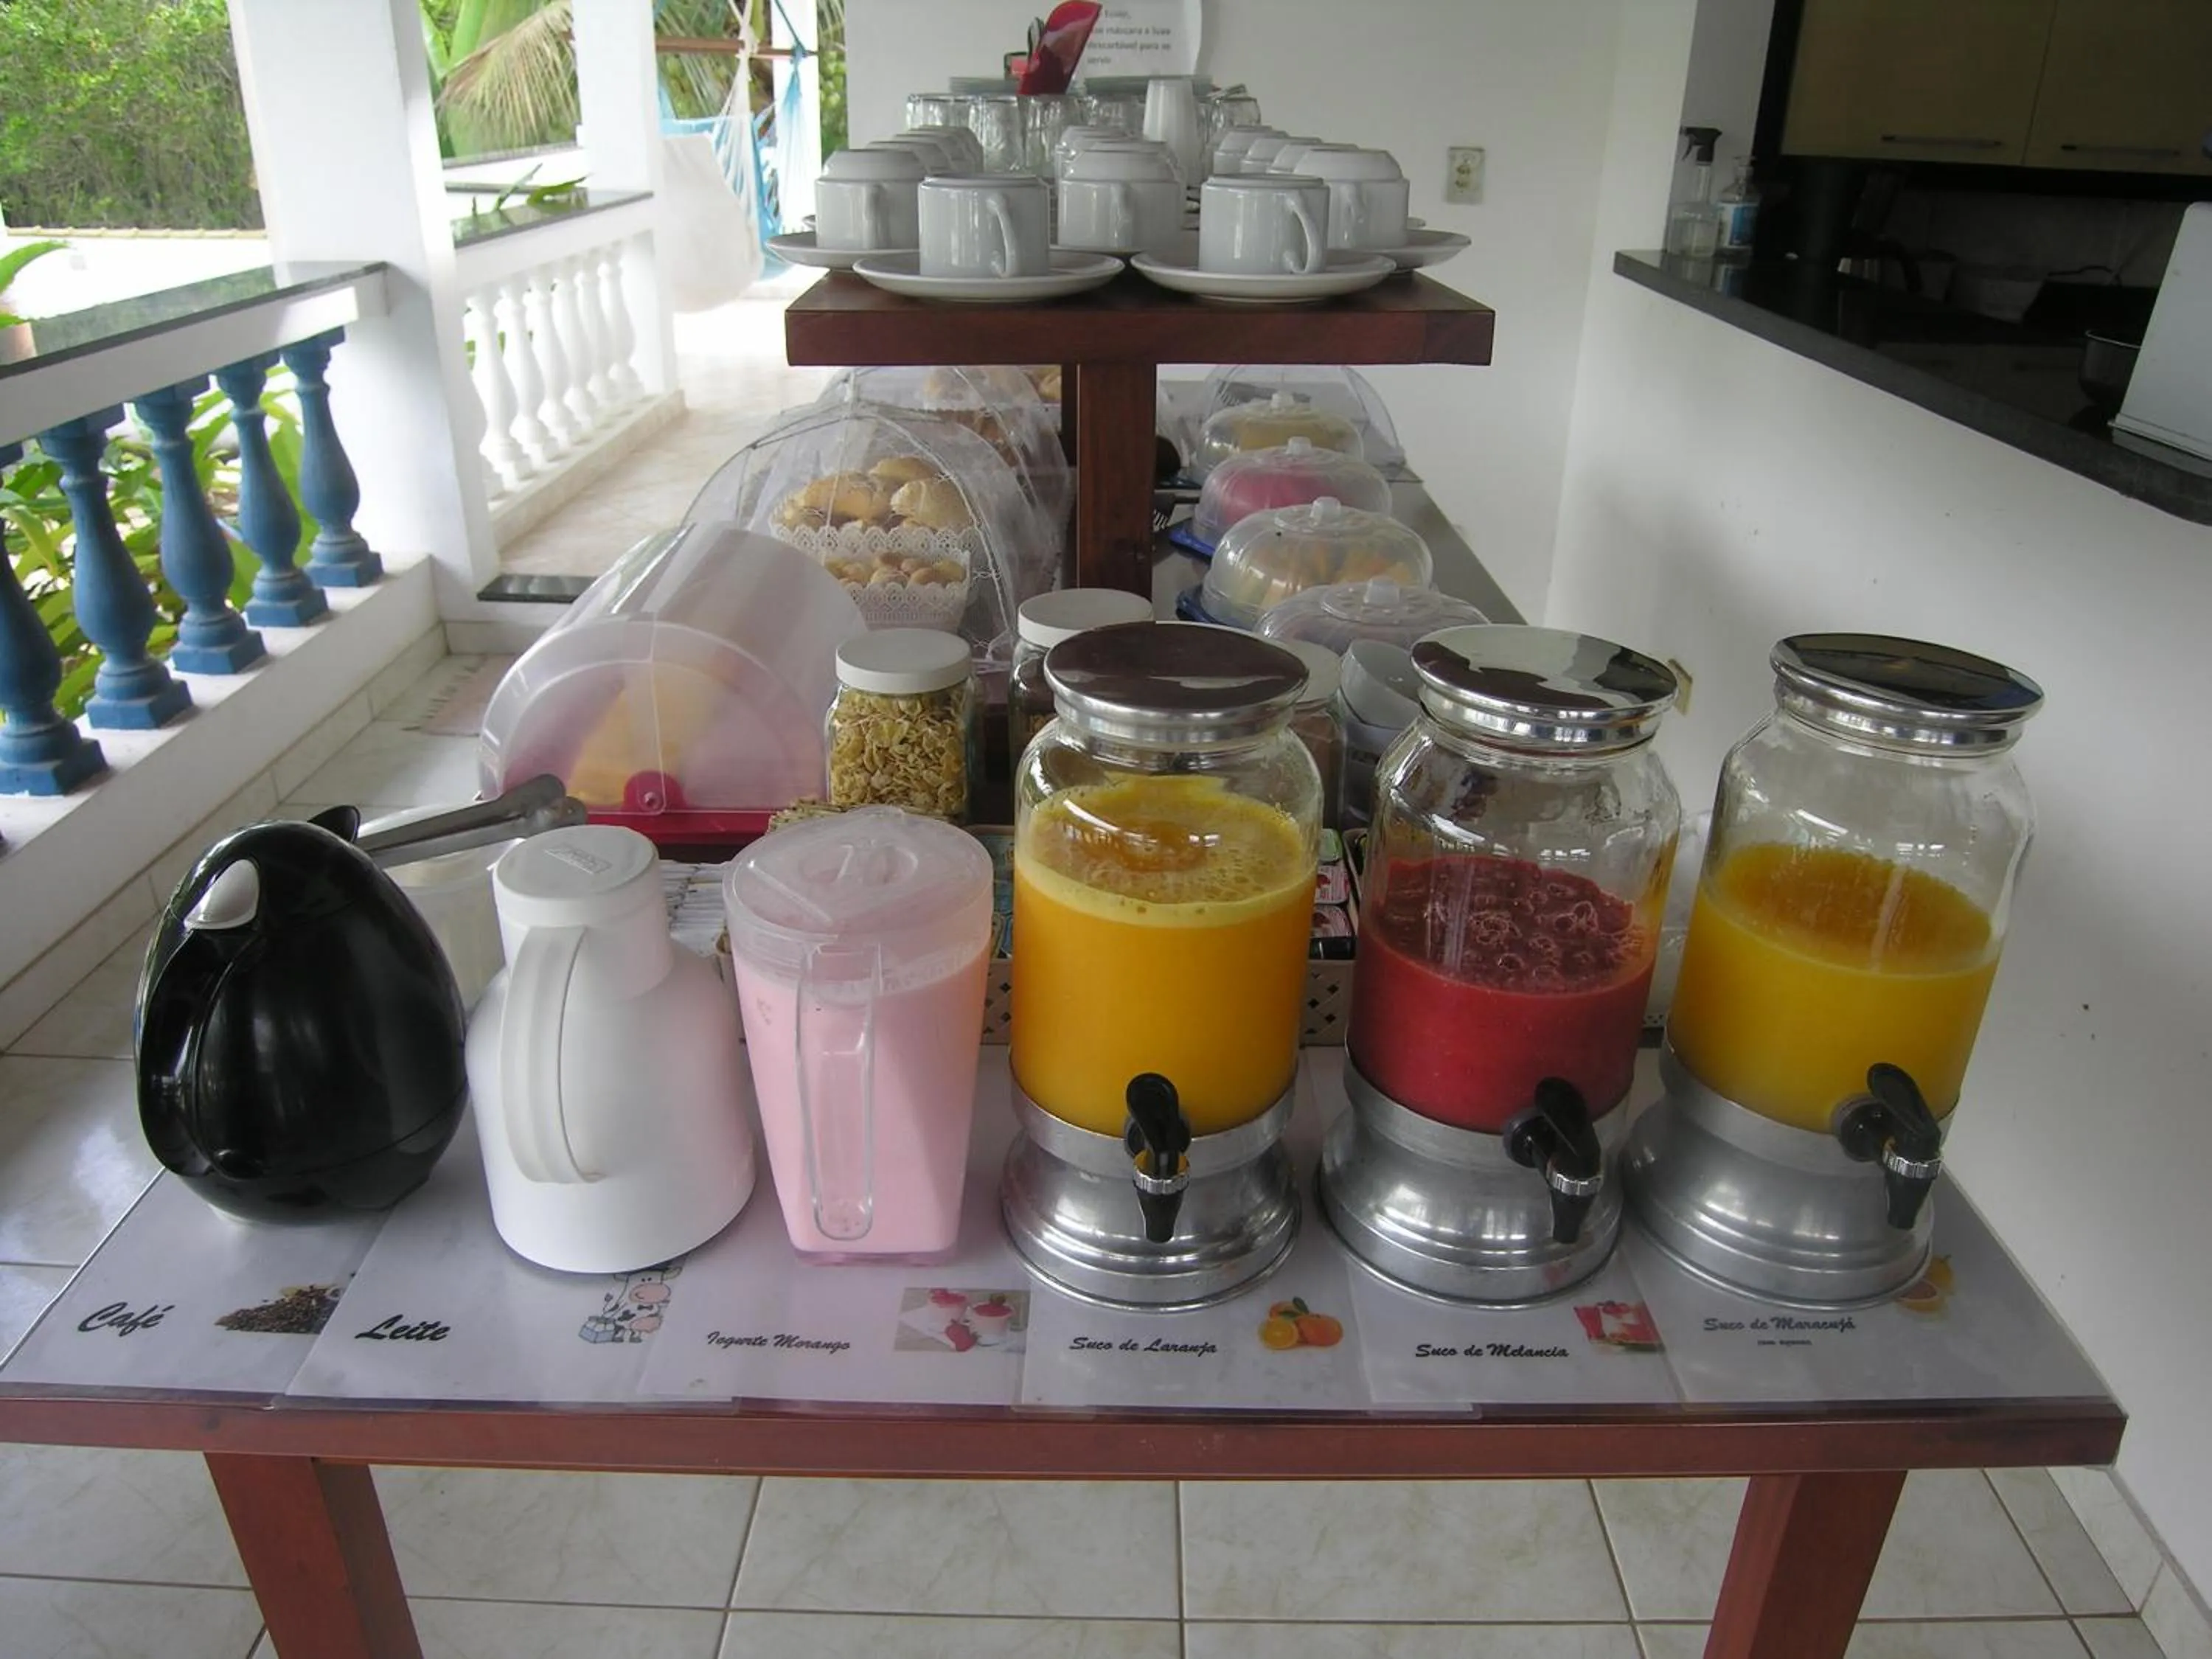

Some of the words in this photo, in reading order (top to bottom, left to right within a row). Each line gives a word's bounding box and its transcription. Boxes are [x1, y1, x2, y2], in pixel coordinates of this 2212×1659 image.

[77, 1302, 175, 1337] Café
[355, 1315, 451, 1341] Leite
[1703, 1318, 1745, 1331] Suco
[1750, 1318, 1769, 1330] de
[1770, 1317, 1856, 1333] Maracujá
[707, 1331, 768, 1349] Iogurte
[773, 1334, 850, 1354] Morango
[1069, 1337, 1113, 1350] Suco
[1119, 1338, 1138, 1351] de
[1143, 1338, 1217, 1357] Laranja
[1416, 1344, 1458, 1357] Suco
[1464, 1344, 1484, 1357] de
[1486, 1343, 1569, 1357] Melancia
